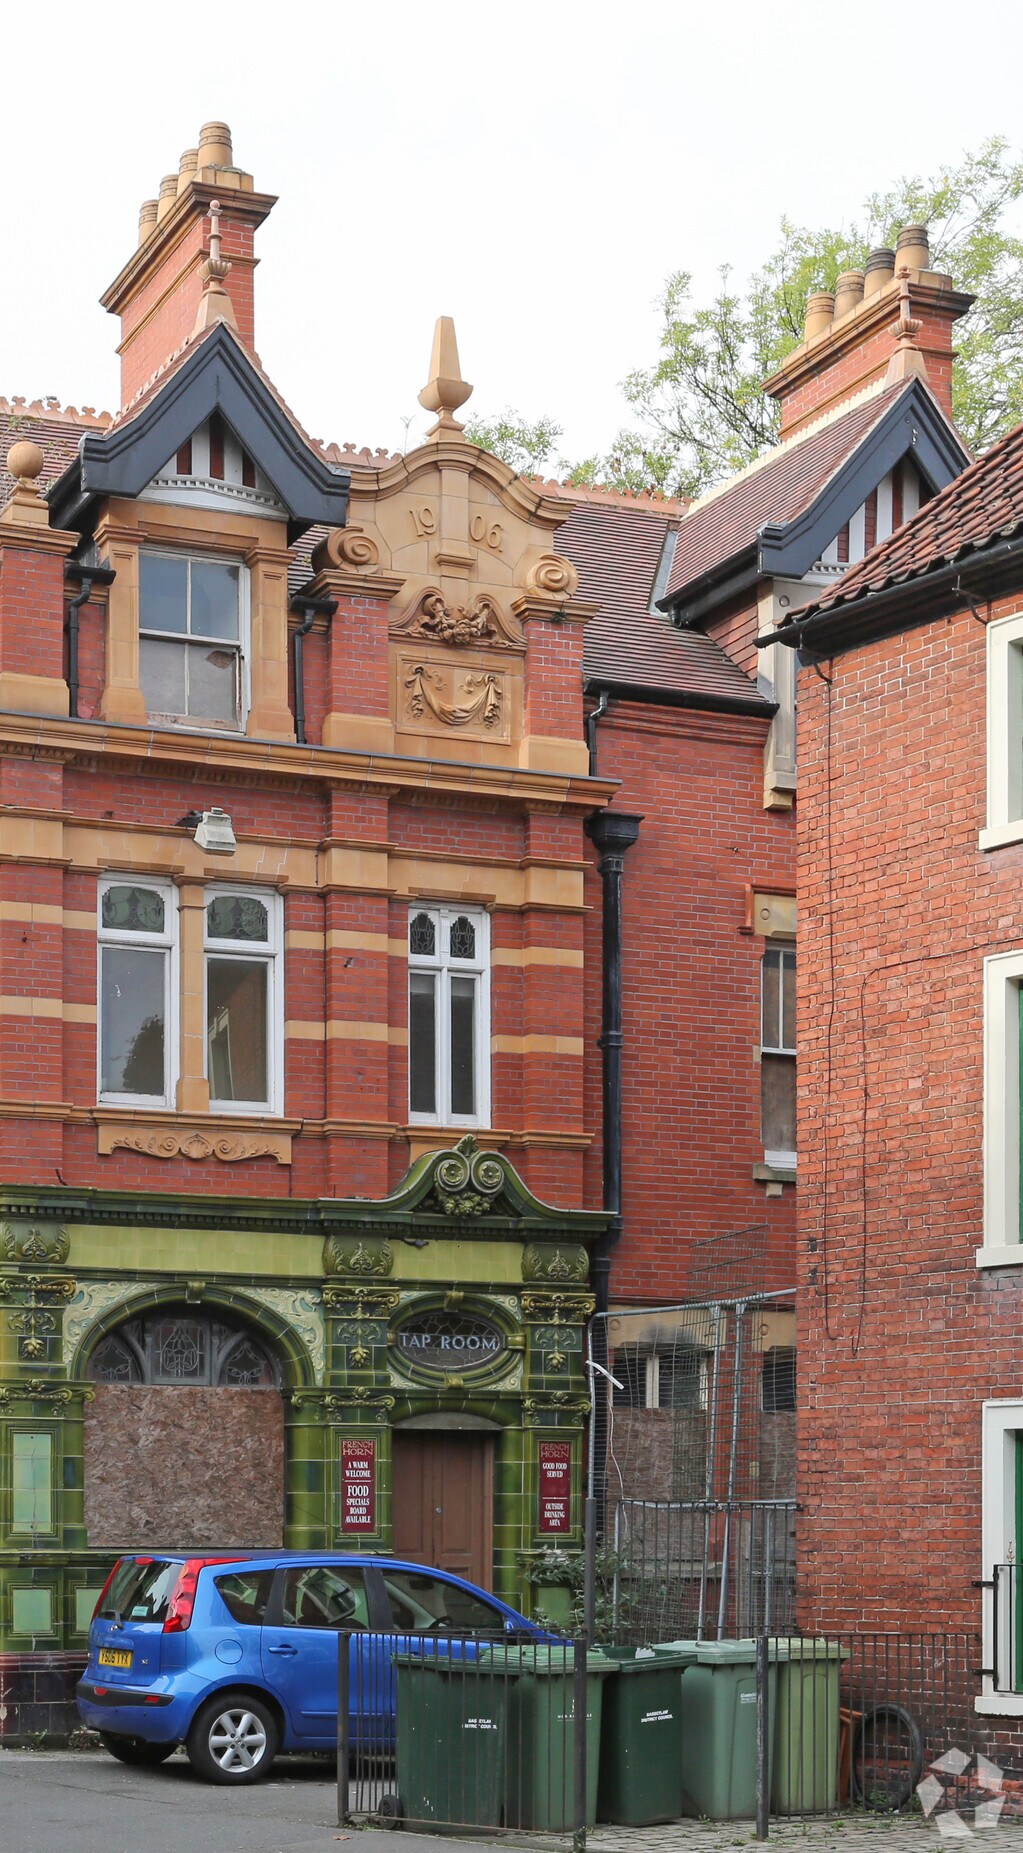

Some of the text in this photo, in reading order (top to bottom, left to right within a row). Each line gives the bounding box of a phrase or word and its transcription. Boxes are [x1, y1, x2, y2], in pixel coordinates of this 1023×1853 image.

[399, 1332, 496, 1350] TAP ROOM
[342, 1440, 373, 1448] FRENCH
[540, 1443, 569, 1451] FRENCH
[540, 1450, 569, 1458] HORN
[348, 1461, 368, 1469] A WARM
[542, 1462, 567, 1470] GOOD FOOD
[345, 1470, 371, 1478] WELCOME
[347, 1485, 369, 1496] FOOD
[346, 1498, 370, 1506] SPECIALS
[350, 1507, 367, 1515] BOARD
[345, 1516, 371, 1524] AVAILABLE
[549, 1519, 561, 1527] AREA
